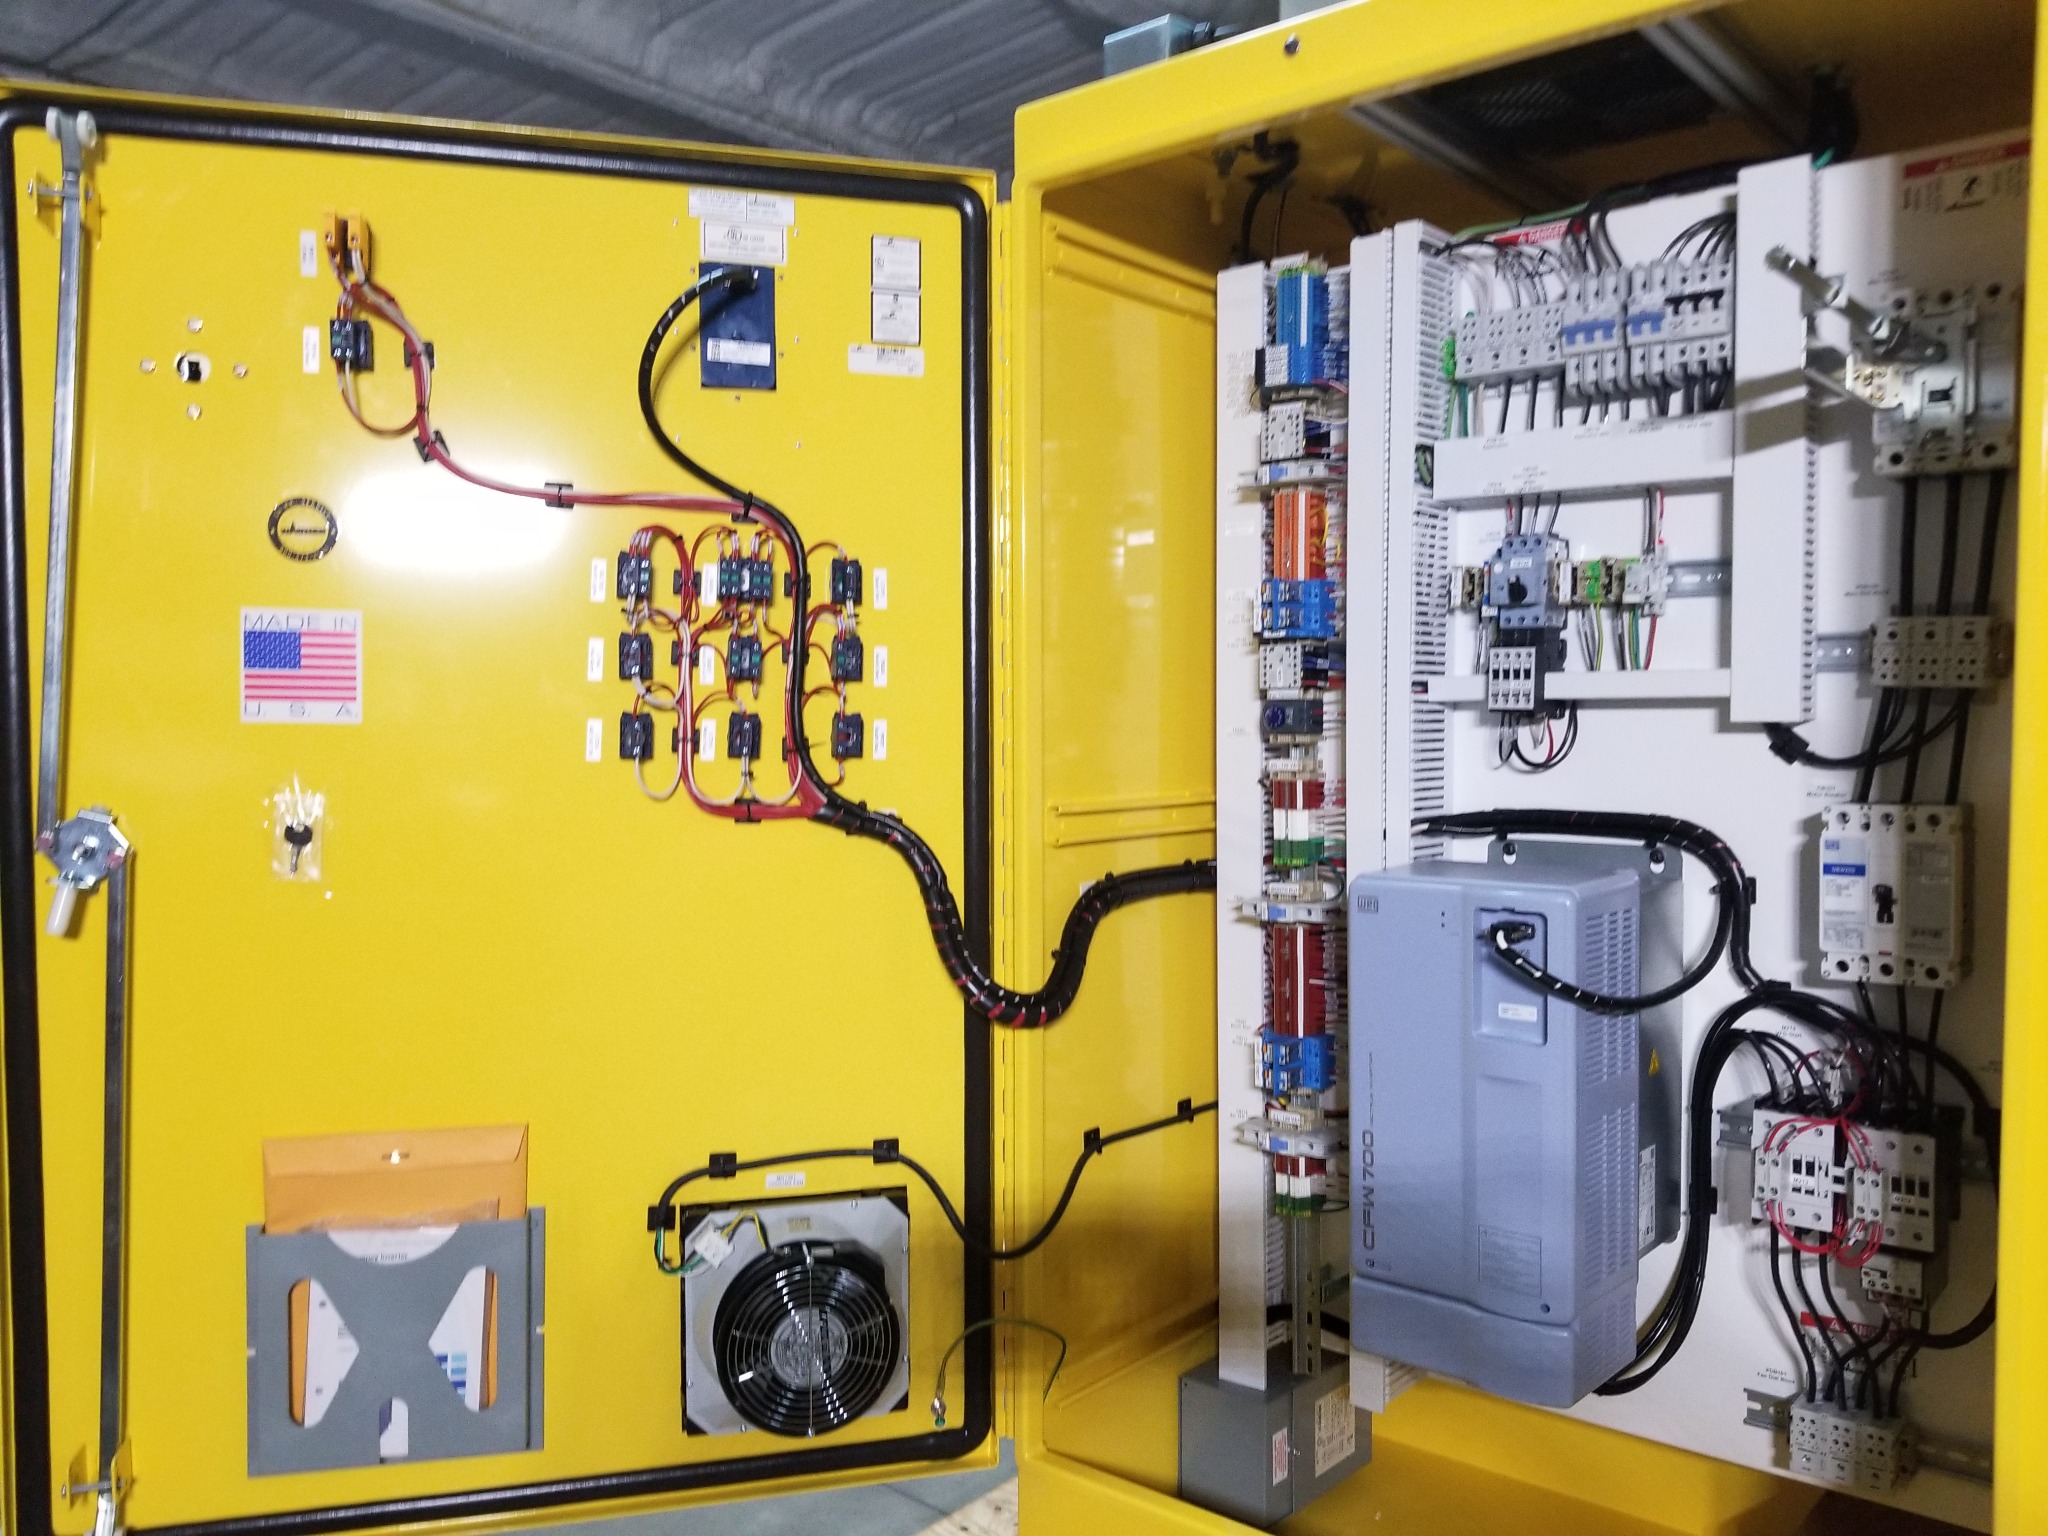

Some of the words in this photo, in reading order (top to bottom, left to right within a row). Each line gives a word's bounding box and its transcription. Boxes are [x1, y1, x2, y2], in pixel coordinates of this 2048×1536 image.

[244, 613, 320, 631] MADE
[333, 616, 356, 632] IN
[1361, 1129, 1375, 1181] 700
[1362, 1186, 1375, 1251] CFW
